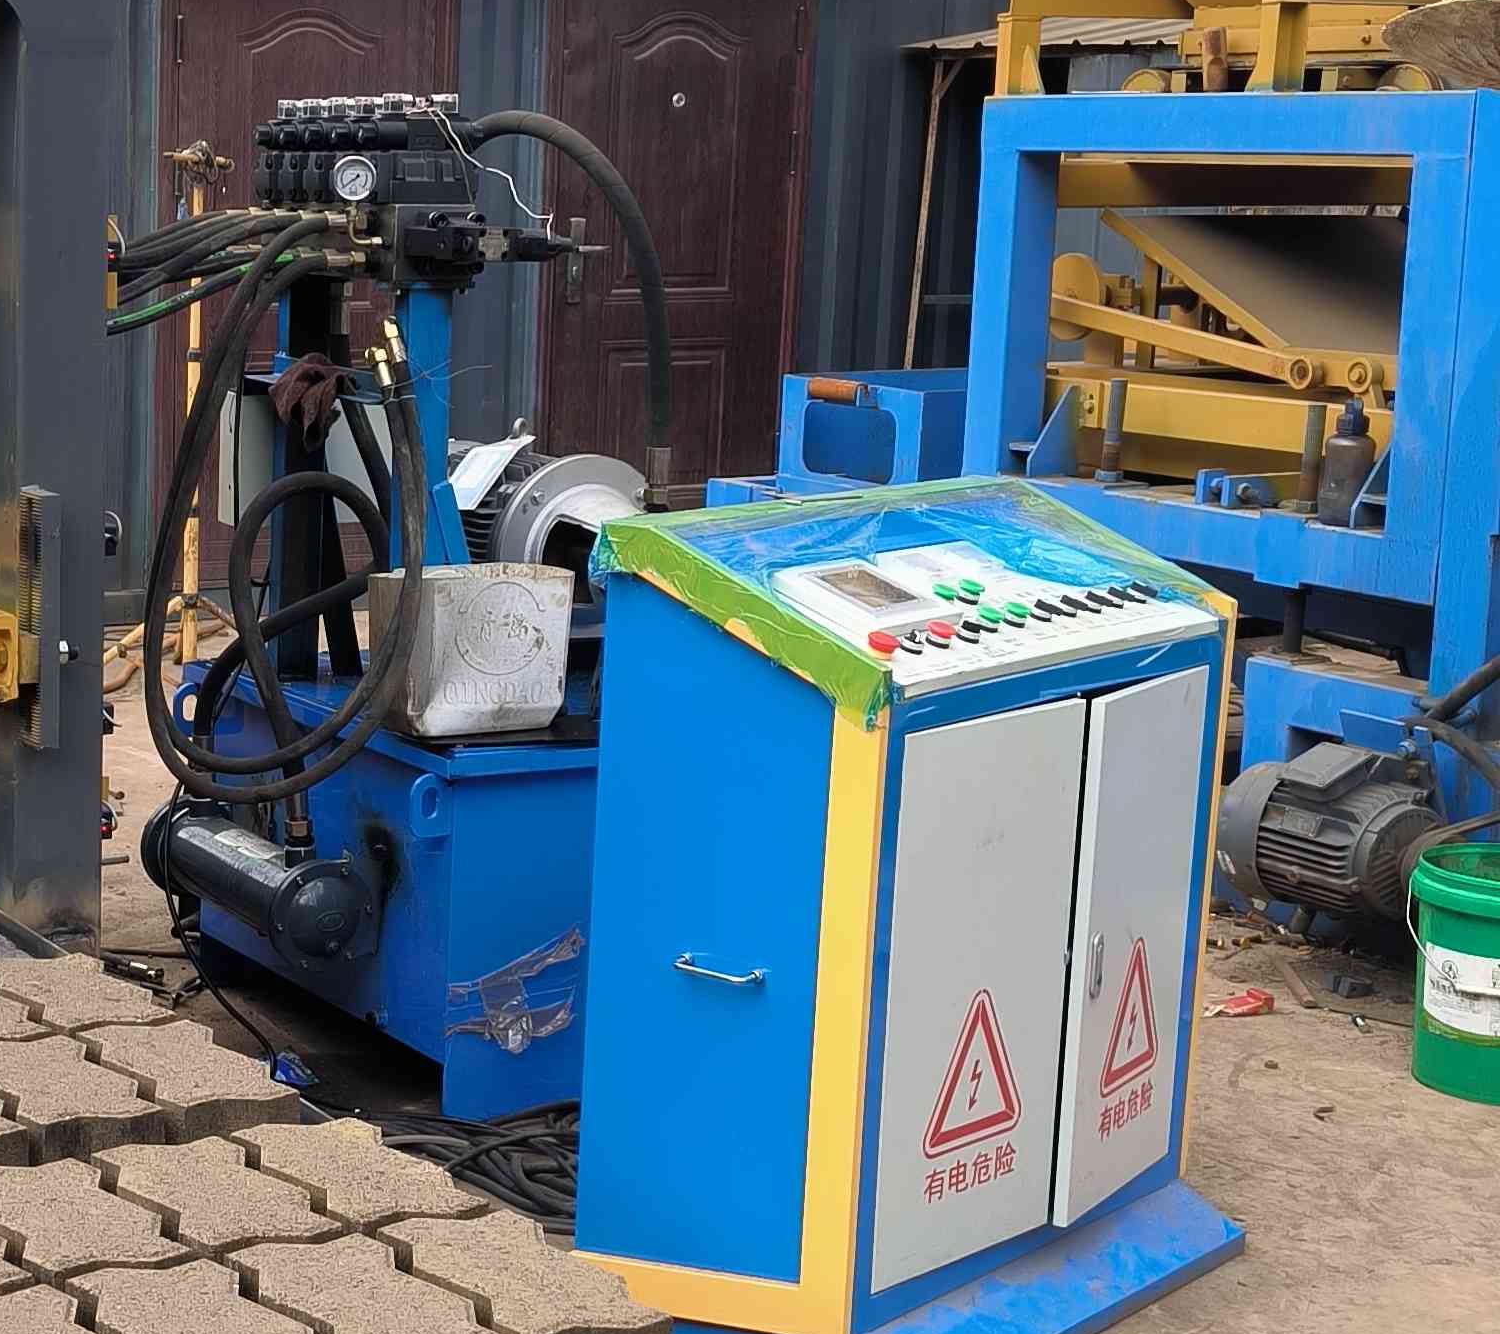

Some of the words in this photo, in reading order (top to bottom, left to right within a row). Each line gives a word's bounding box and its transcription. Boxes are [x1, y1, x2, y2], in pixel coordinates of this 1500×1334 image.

[1098, 1079, 1153, 1142] 有电危险
[923, 1140, 1017, 1203] 有电危险
